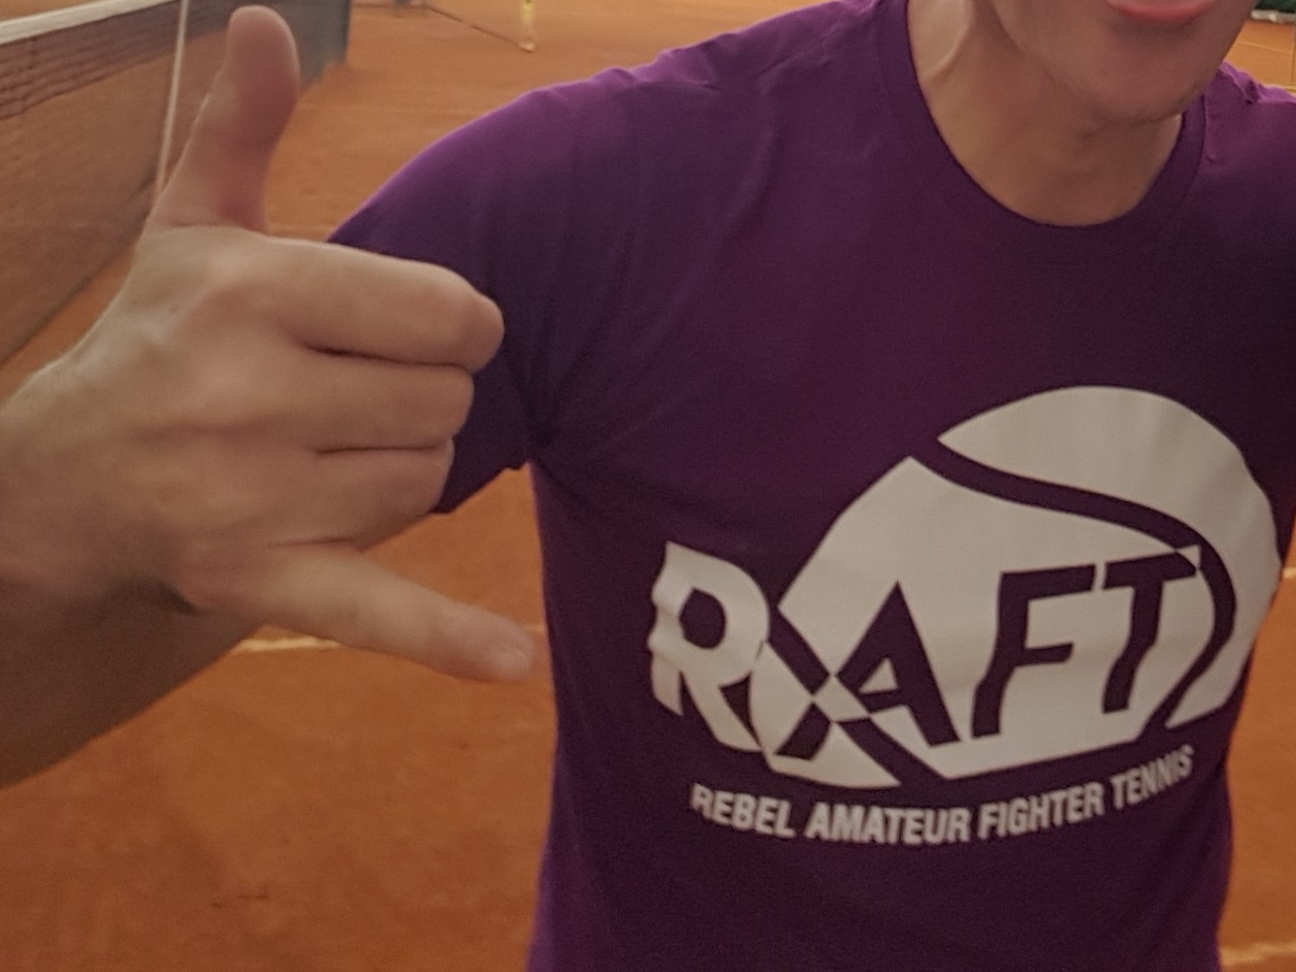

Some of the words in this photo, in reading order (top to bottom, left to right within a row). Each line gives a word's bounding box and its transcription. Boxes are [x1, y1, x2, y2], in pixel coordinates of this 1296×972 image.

[647, 540, 1198, 759] RAFT
[690, 783, 797, 839] REBEL
[805, 803, 971, 845] AMATEUR
[977, 778, 1103, 839] FIGHTER
[1112, 745, 1194, 807] TENNIS
